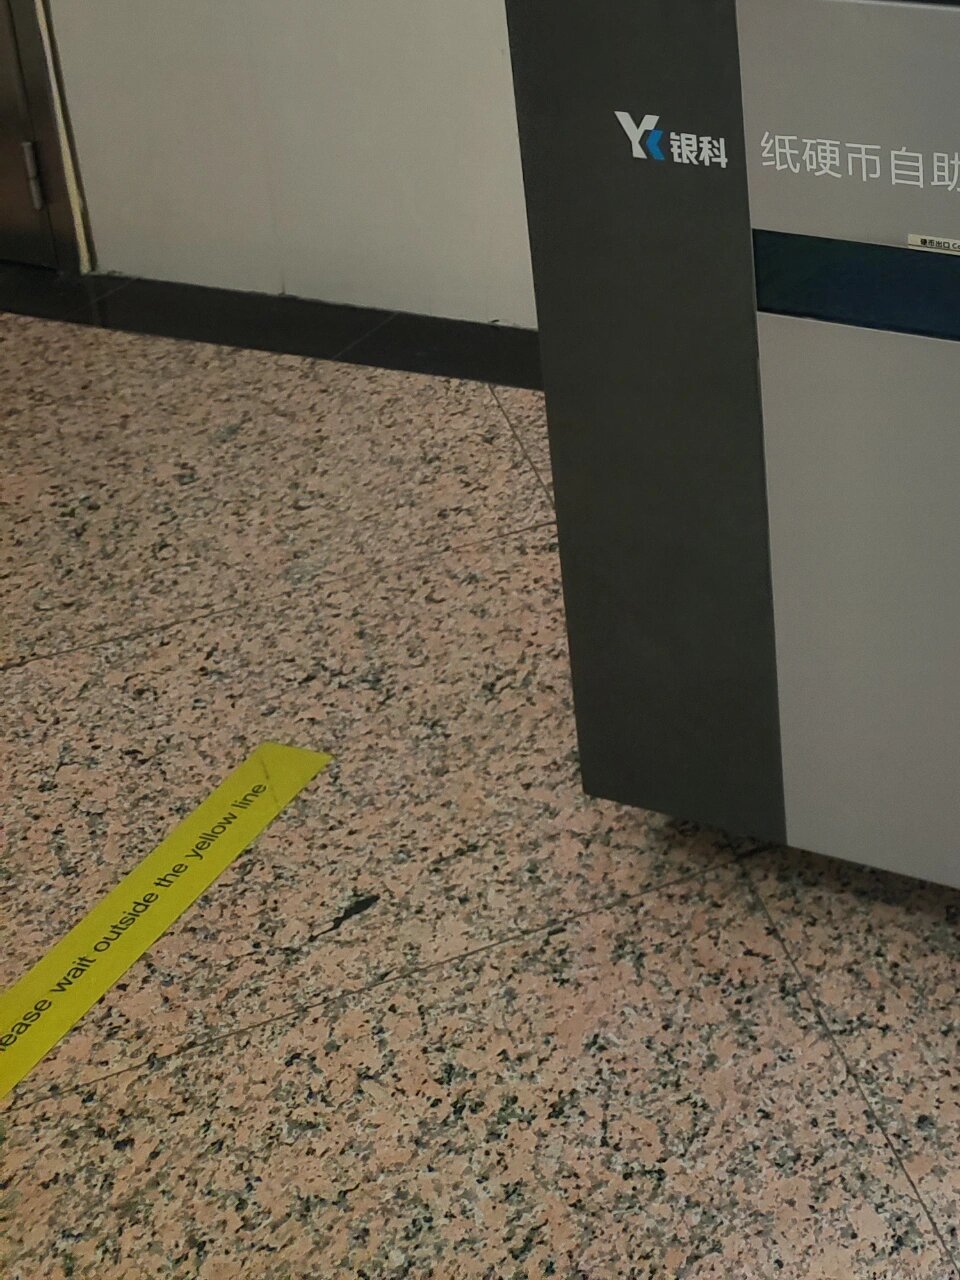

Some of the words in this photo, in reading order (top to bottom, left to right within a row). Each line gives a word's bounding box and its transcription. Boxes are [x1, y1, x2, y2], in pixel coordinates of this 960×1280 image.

[670, 131, 728, 169] 银科
[920, 238, 950, 249] 硬币出口
[51, 955, 96, 994] wait
[94, 892, 159, 953] outside
[154, 862, 188, 889] the
[186, 811, 239, 860] yellow
[231, 782, 268, 811] line
